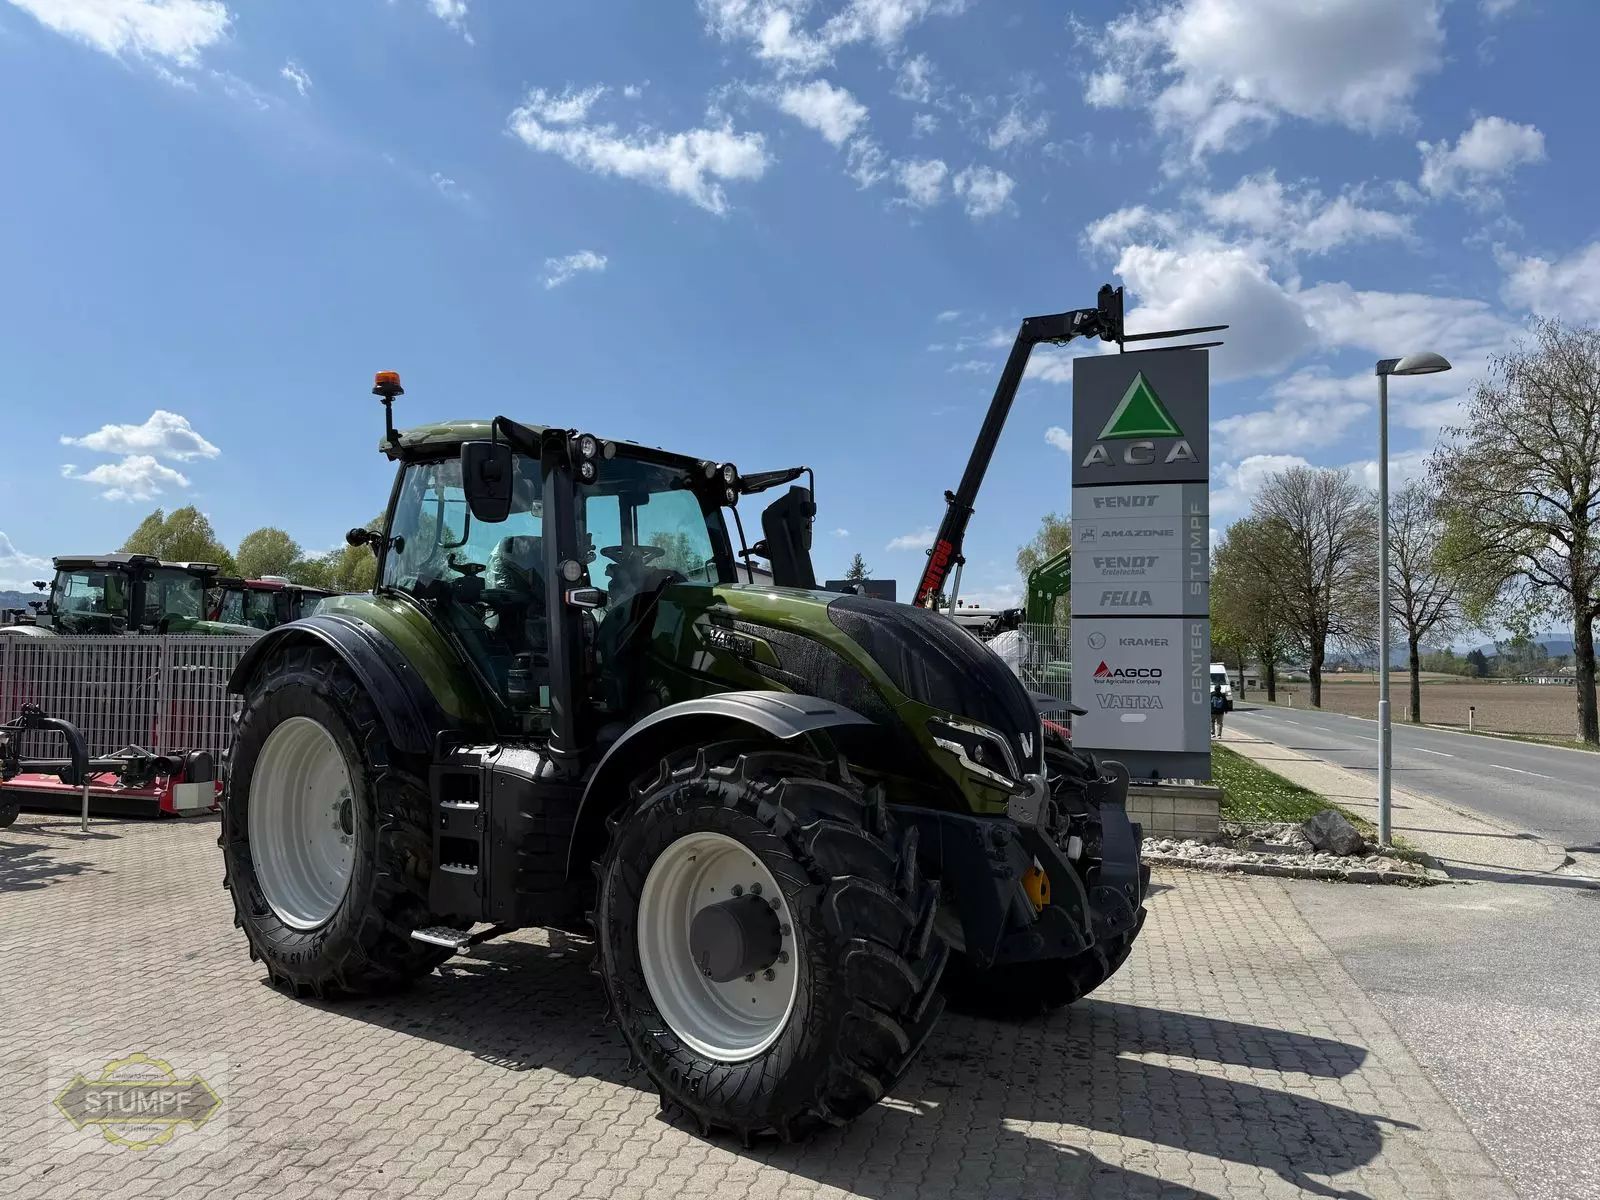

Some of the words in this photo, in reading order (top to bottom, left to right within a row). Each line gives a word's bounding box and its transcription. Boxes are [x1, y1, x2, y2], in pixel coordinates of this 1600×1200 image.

[1081, 440, 1200, 468] ACA
[1093, 495, 1160, 508] FENDT
[1101, 529, 1175, 538] AMAZONE
[1190, 502, 1201, 595] STUMPF
[1093, 556, 1159, 568] FENDT
[1100, 591, 1153, 606] FELLA
[1119, 638, 1169, 646] KRAMER
[1191, 623, 1202, 704] CENTER
[1113, 668, 1162, 677] AGCO
[1096, 694, 1163, 709] VALTRA
